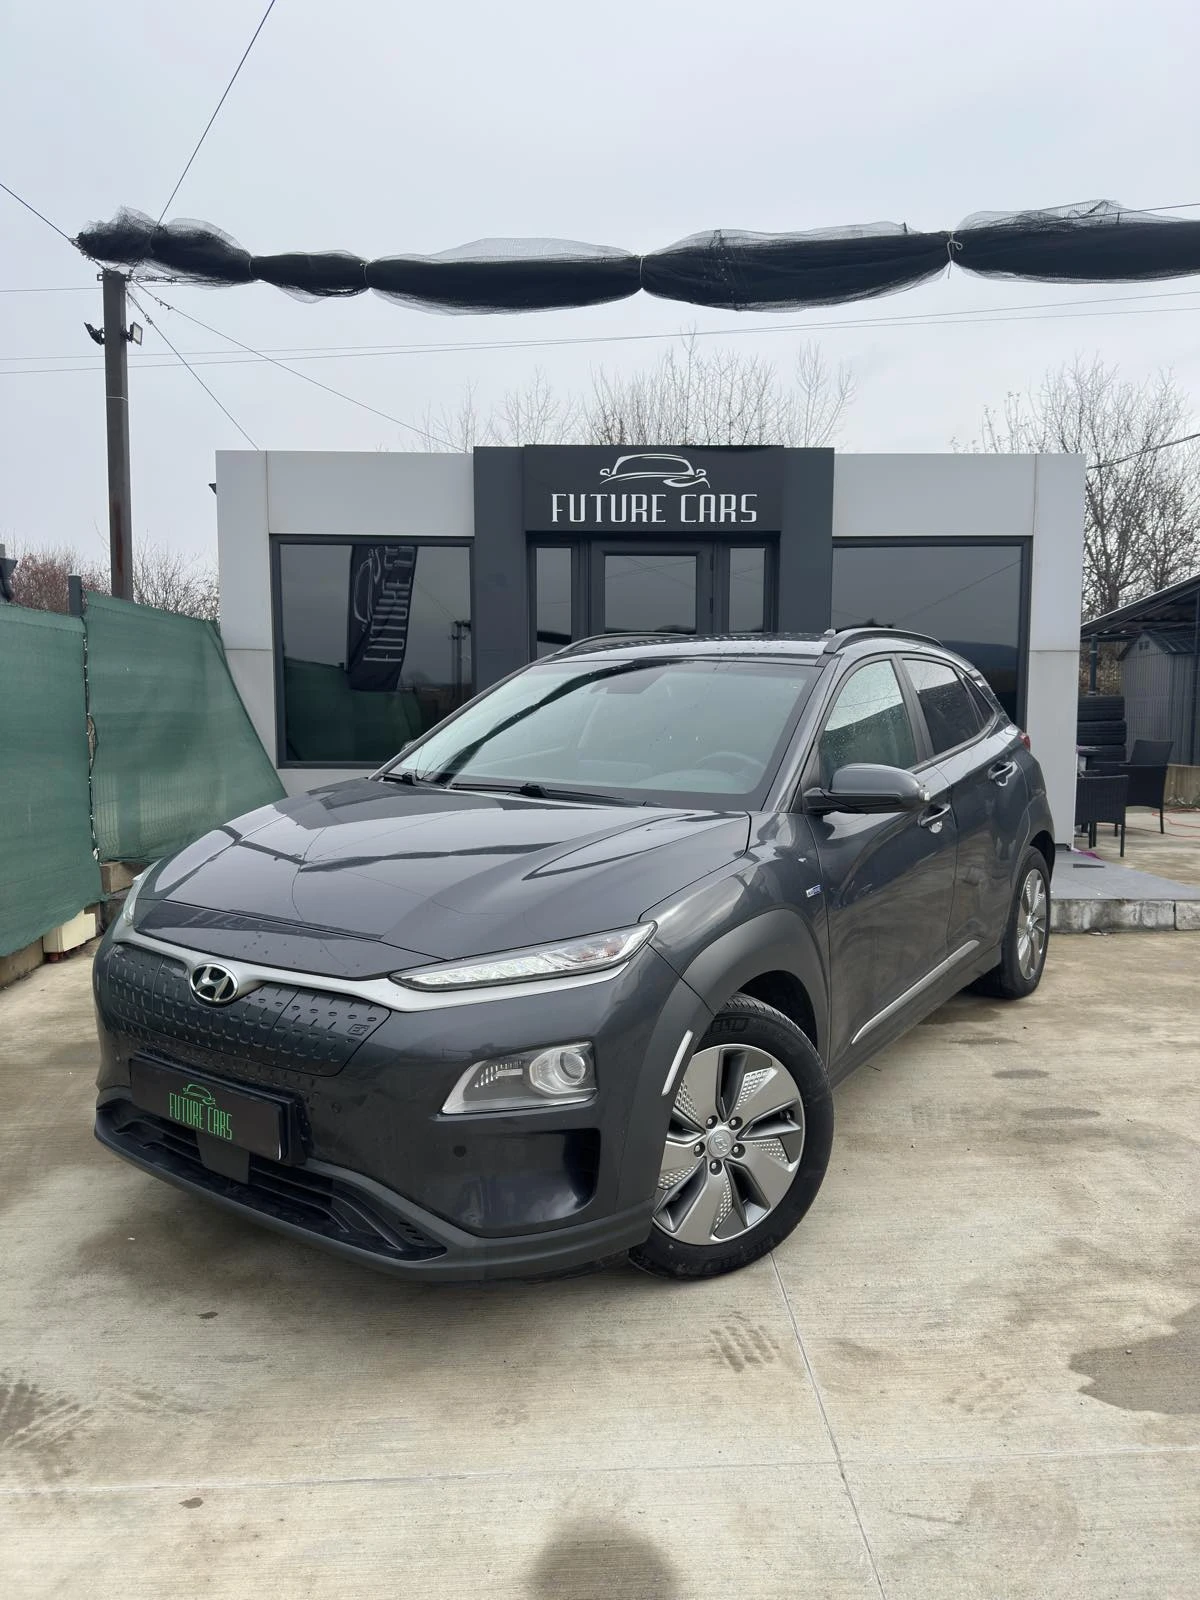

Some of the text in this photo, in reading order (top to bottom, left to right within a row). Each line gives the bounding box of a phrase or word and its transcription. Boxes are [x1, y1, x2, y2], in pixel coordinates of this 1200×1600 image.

[551, 493, 758, 523] FUTURE CARS
[169, 1092, 233, 1141] FUTURE CARS
